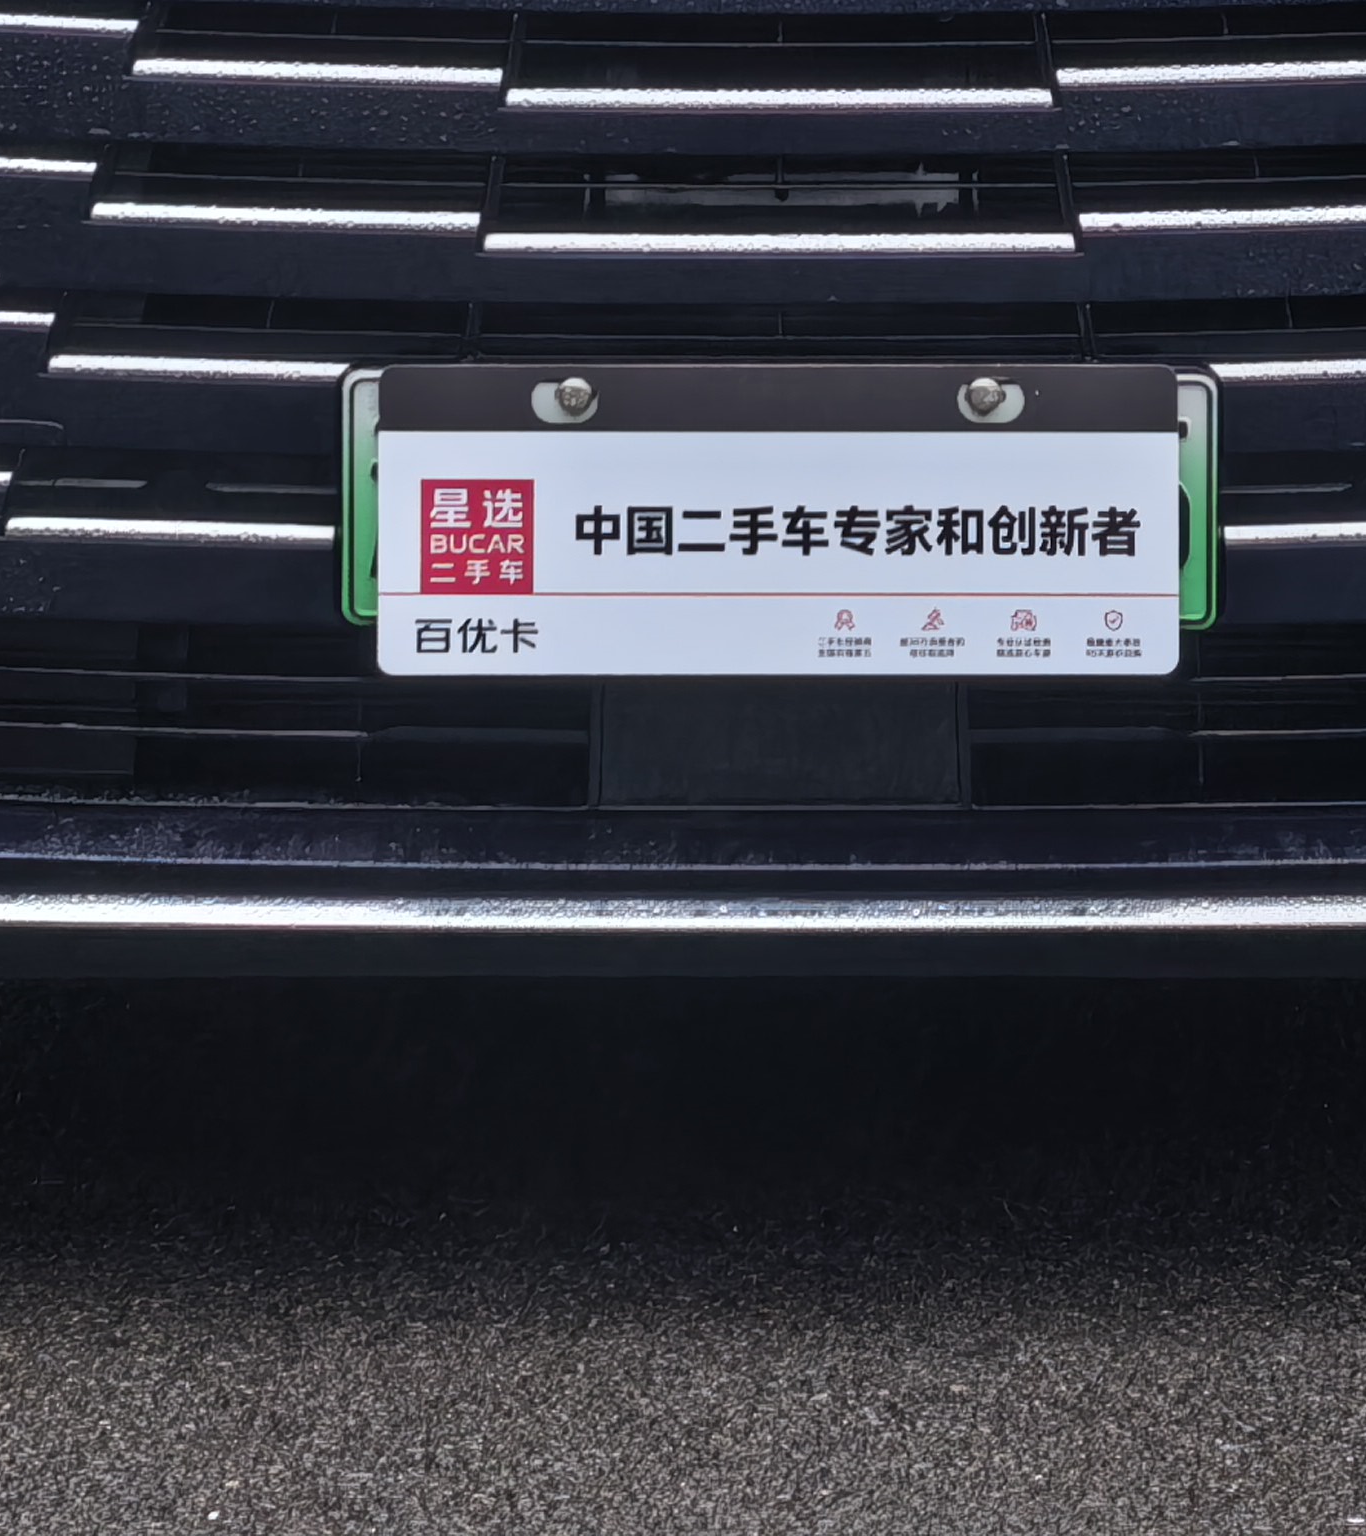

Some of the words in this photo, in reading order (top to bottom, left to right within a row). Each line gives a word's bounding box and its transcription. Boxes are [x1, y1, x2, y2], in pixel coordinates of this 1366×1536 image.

[430, 488, 523, 528] 星选
[430, 533, 525, 554] BUCAR
[575, 505, 1141, 557] 中国二手车专家和创新者
[430, 559, 523, 585] 二手车
[415, 618, 539, 653] 百优卡
